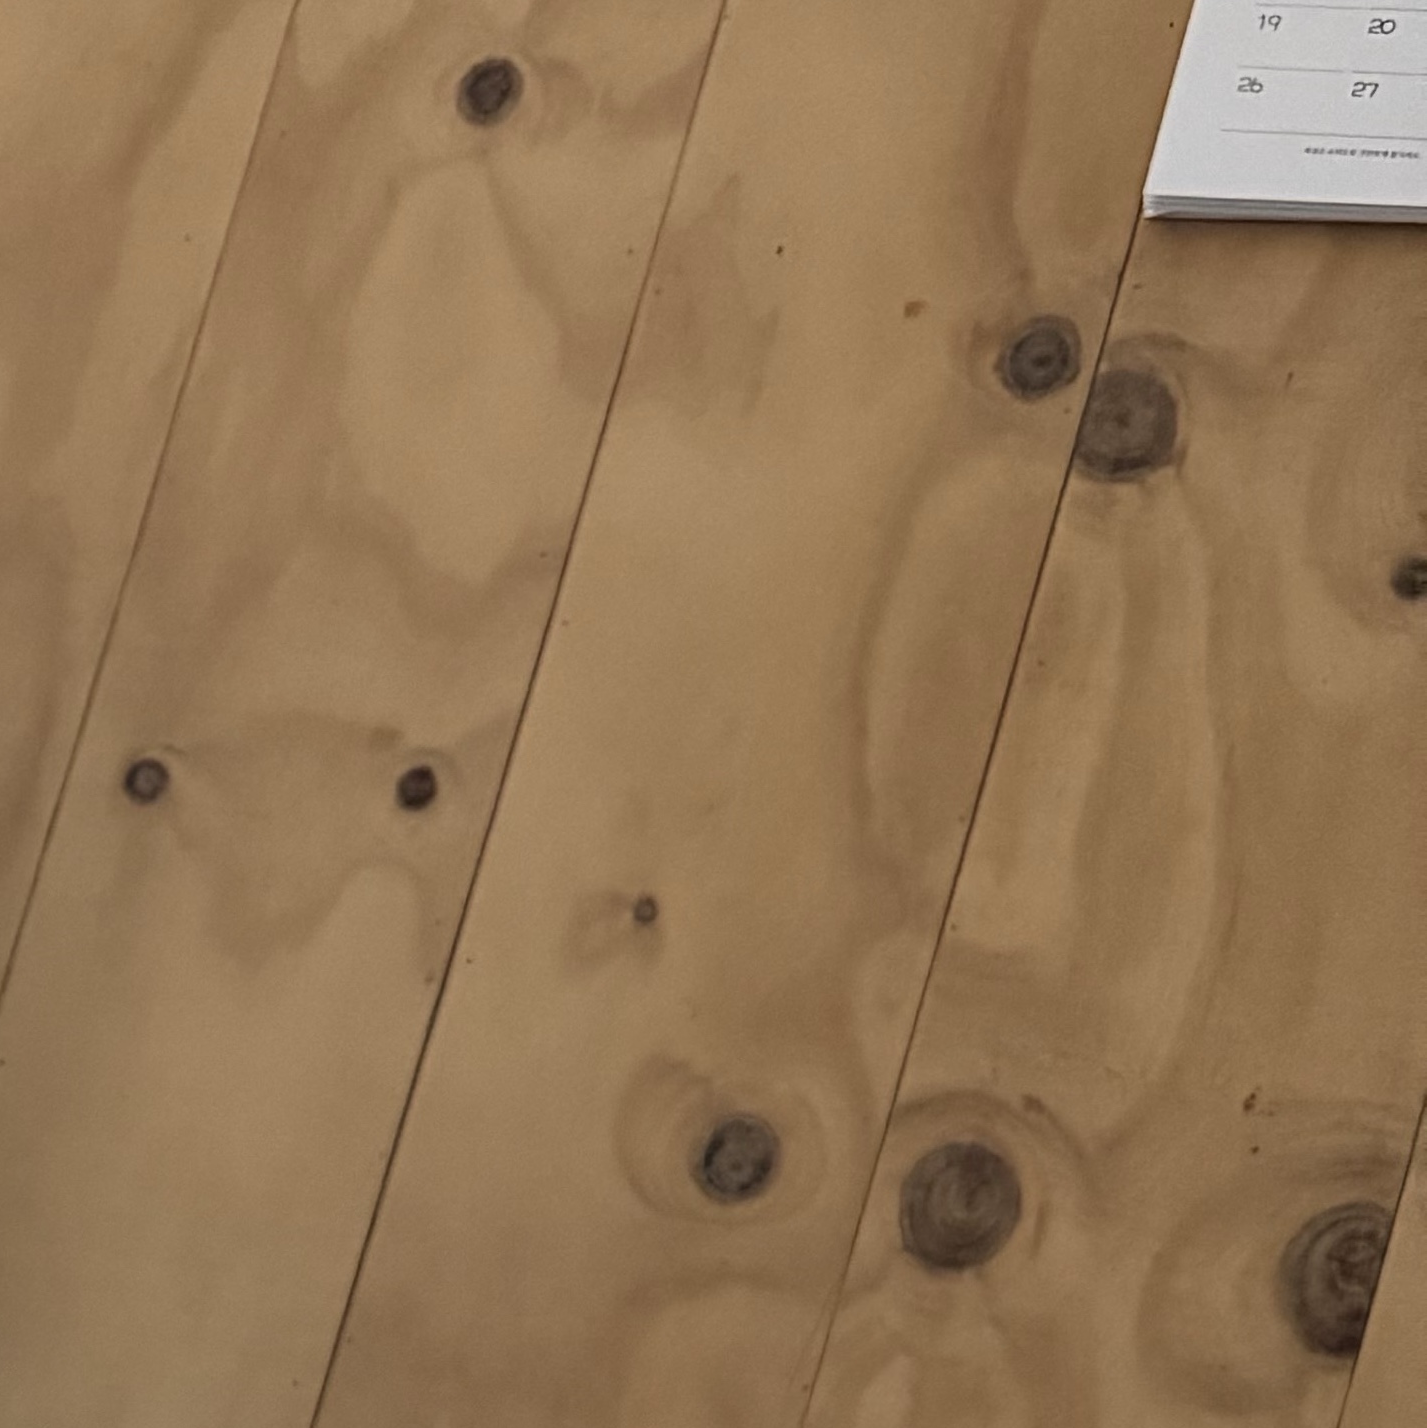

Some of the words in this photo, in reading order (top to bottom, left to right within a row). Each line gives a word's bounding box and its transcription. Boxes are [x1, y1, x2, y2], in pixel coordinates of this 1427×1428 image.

[1258, 14, 1282, 32] 19
[1368, 18, 1397, 35] 20
[1236, 76, 1264, 94] 26
[1351, 81, 1380, 98] 27
